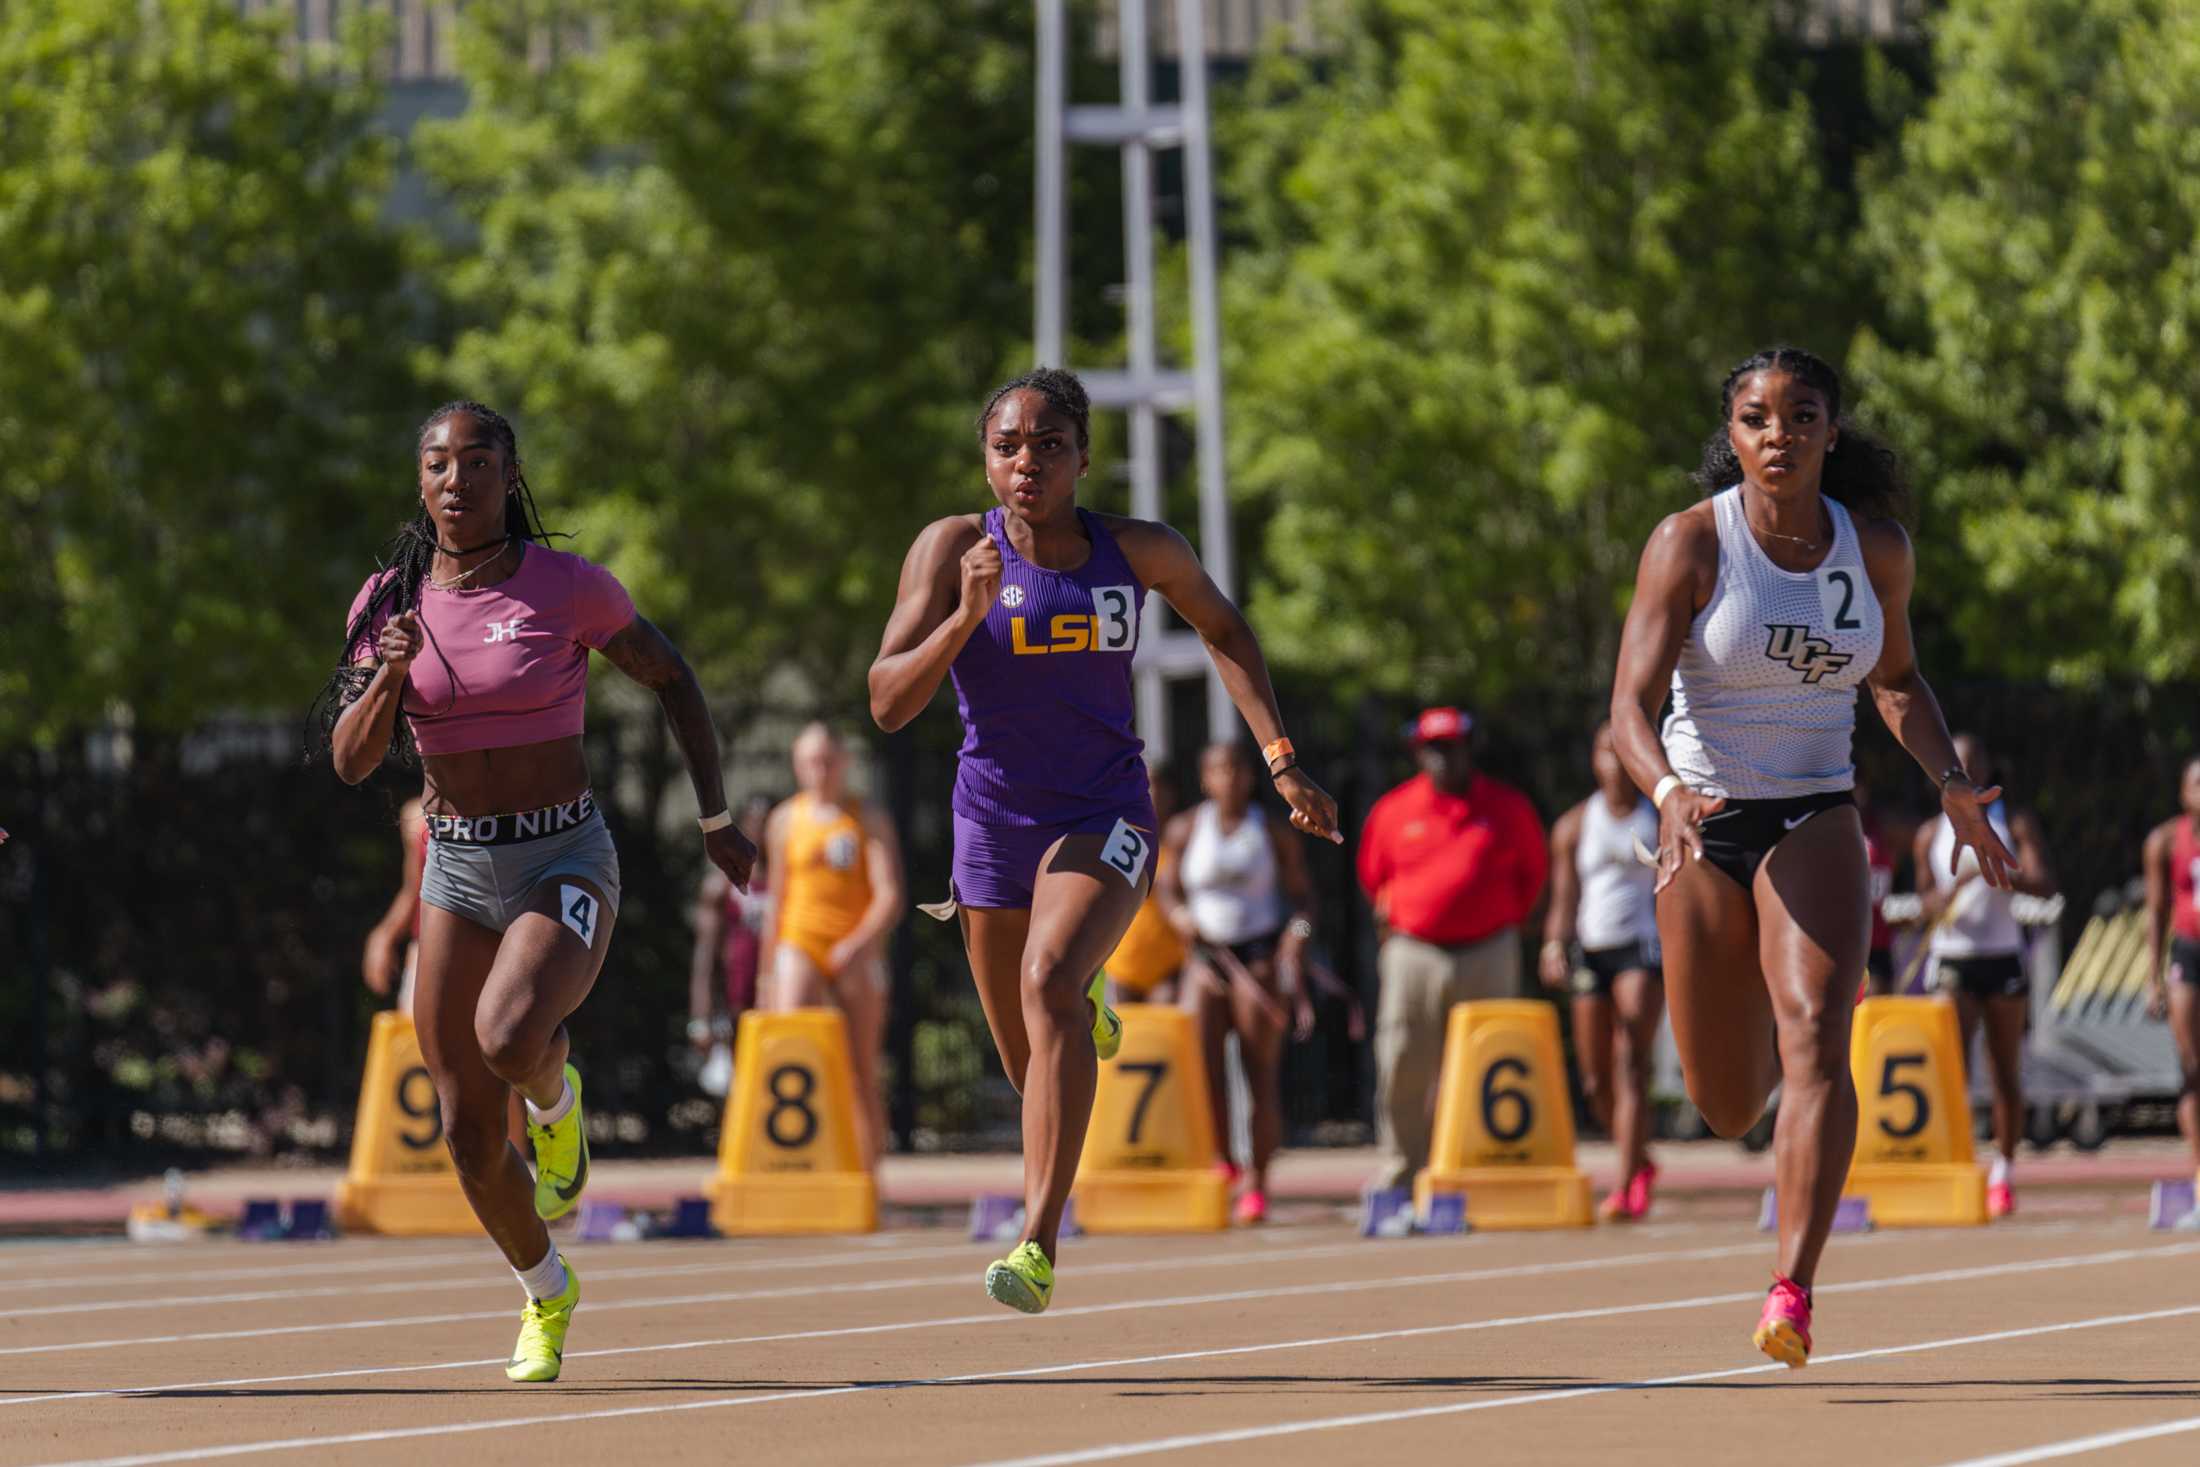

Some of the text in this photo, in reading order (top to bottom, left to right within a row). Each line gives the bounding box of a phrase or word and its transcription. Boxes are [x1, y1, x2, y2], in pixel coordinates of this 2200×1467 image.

[1002, 586, 1023, 607] SEC
[1103, 590, 1128, 647] 3
[1827, 568, 1860, 630] 2
[1010, 614, 1098, 655] LS
[1763, 623, 1854, 683] UCF
[434, 794, 593, 842] PRO NIKE
[1110, 829, 1141, 873] 3
[569, 894, 592, 938] 4
[398, 1066, 443, 1149] 9
[767, 1065, 817, 1149] 8
[1118, 1063, 1168, 1145] 7
[1481, 1057, 1532, 1142] 6
[1879, 1054, 1930, 1138] 5
